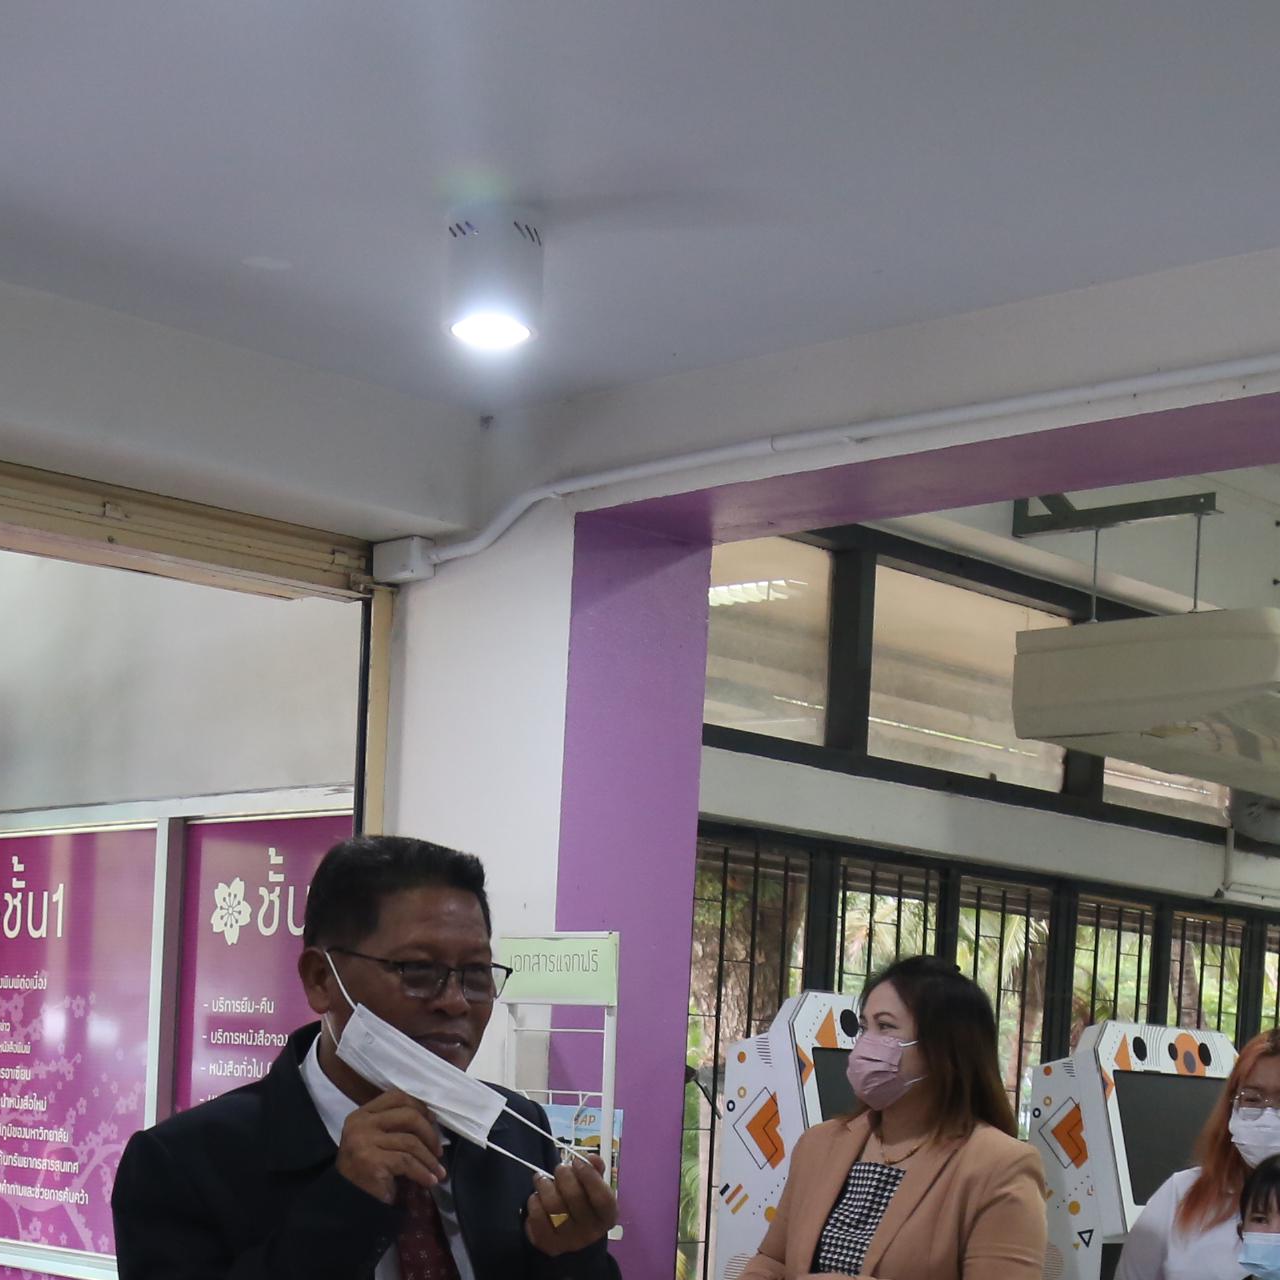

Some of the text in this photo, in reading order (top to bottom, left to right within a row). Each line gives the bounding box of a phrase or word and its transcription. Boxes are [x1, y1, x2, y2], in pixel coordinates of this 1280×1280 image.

[3, 855, 64, 939] ชั้น1
[510, 949, 599, 973] เอกสารแจกฟรี
[212, 997, 274, 1014] บริการยืม-คืน
[209, 1057, 263, 1078] หนังสือทั่วไป
